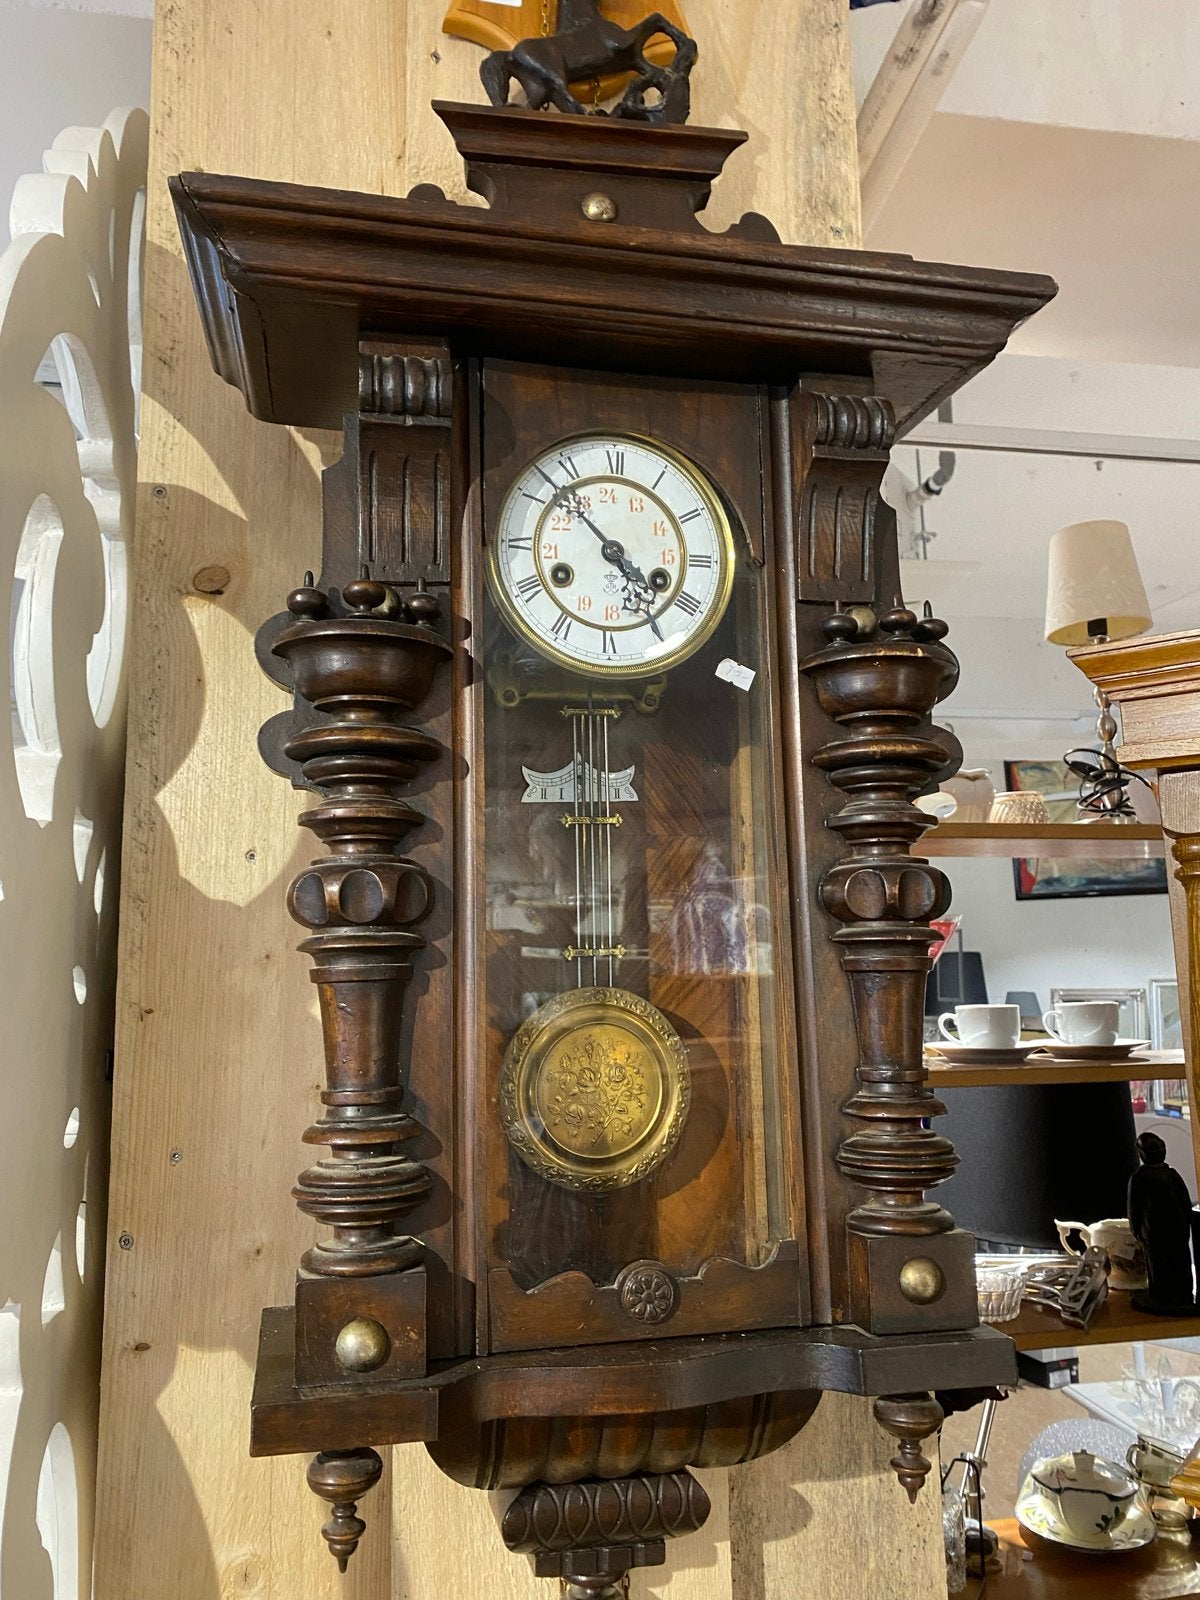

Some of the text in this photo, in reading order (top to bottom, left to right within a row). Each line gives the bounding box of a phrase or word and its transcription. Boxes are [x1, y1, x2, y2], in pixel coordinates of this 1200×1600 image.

[604, 450, 625, 476] XII
[599, 487, 617, 504] 24
[629, 496, 645, 513] 13
[551, 515, 572, 531] 22
[678, 507, 701, 525] II
[653, 520, 668, 537] 14
[542, 543, 559, 560] 21
[661, 549, 676, 565] 15
[689, 554, 712, 569] III
[577, 594, 592, 612] 19
[604, 604, 620, 621] 18
